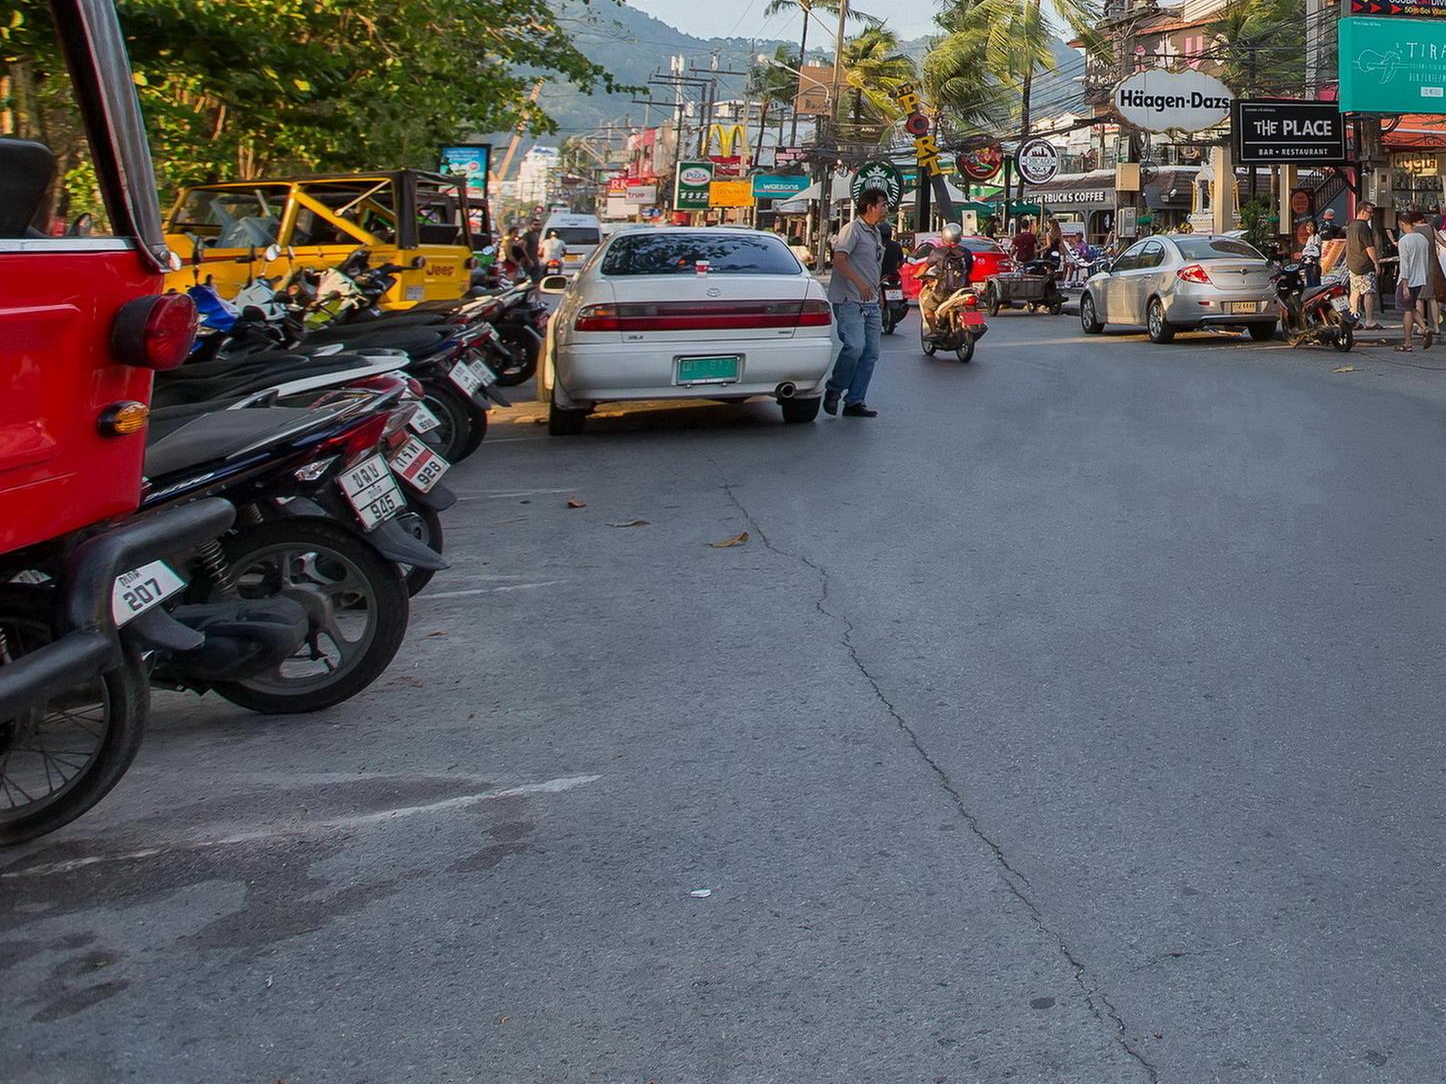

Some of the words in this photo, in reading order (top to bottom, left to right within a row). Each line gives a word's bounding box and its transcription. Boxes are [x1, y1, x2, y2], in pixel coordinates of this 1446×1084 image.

[1253, 119, 1279, 136] THE
[1283, 119, 1332, 136] PLACE
[1258, 148, 1274, 156] BAR
[1281, 148, 1328, 156] RESTAURANT
[1026, 192, 1073, 204] STARBUCKS
[1074, 191, 1104, 202] COFFEE
[426, 265, 455, 276] Jeep
[416, 461, 441, 486] 928
[369, 495, 395, 520] 945
[122, 577, 163, 612] 207
